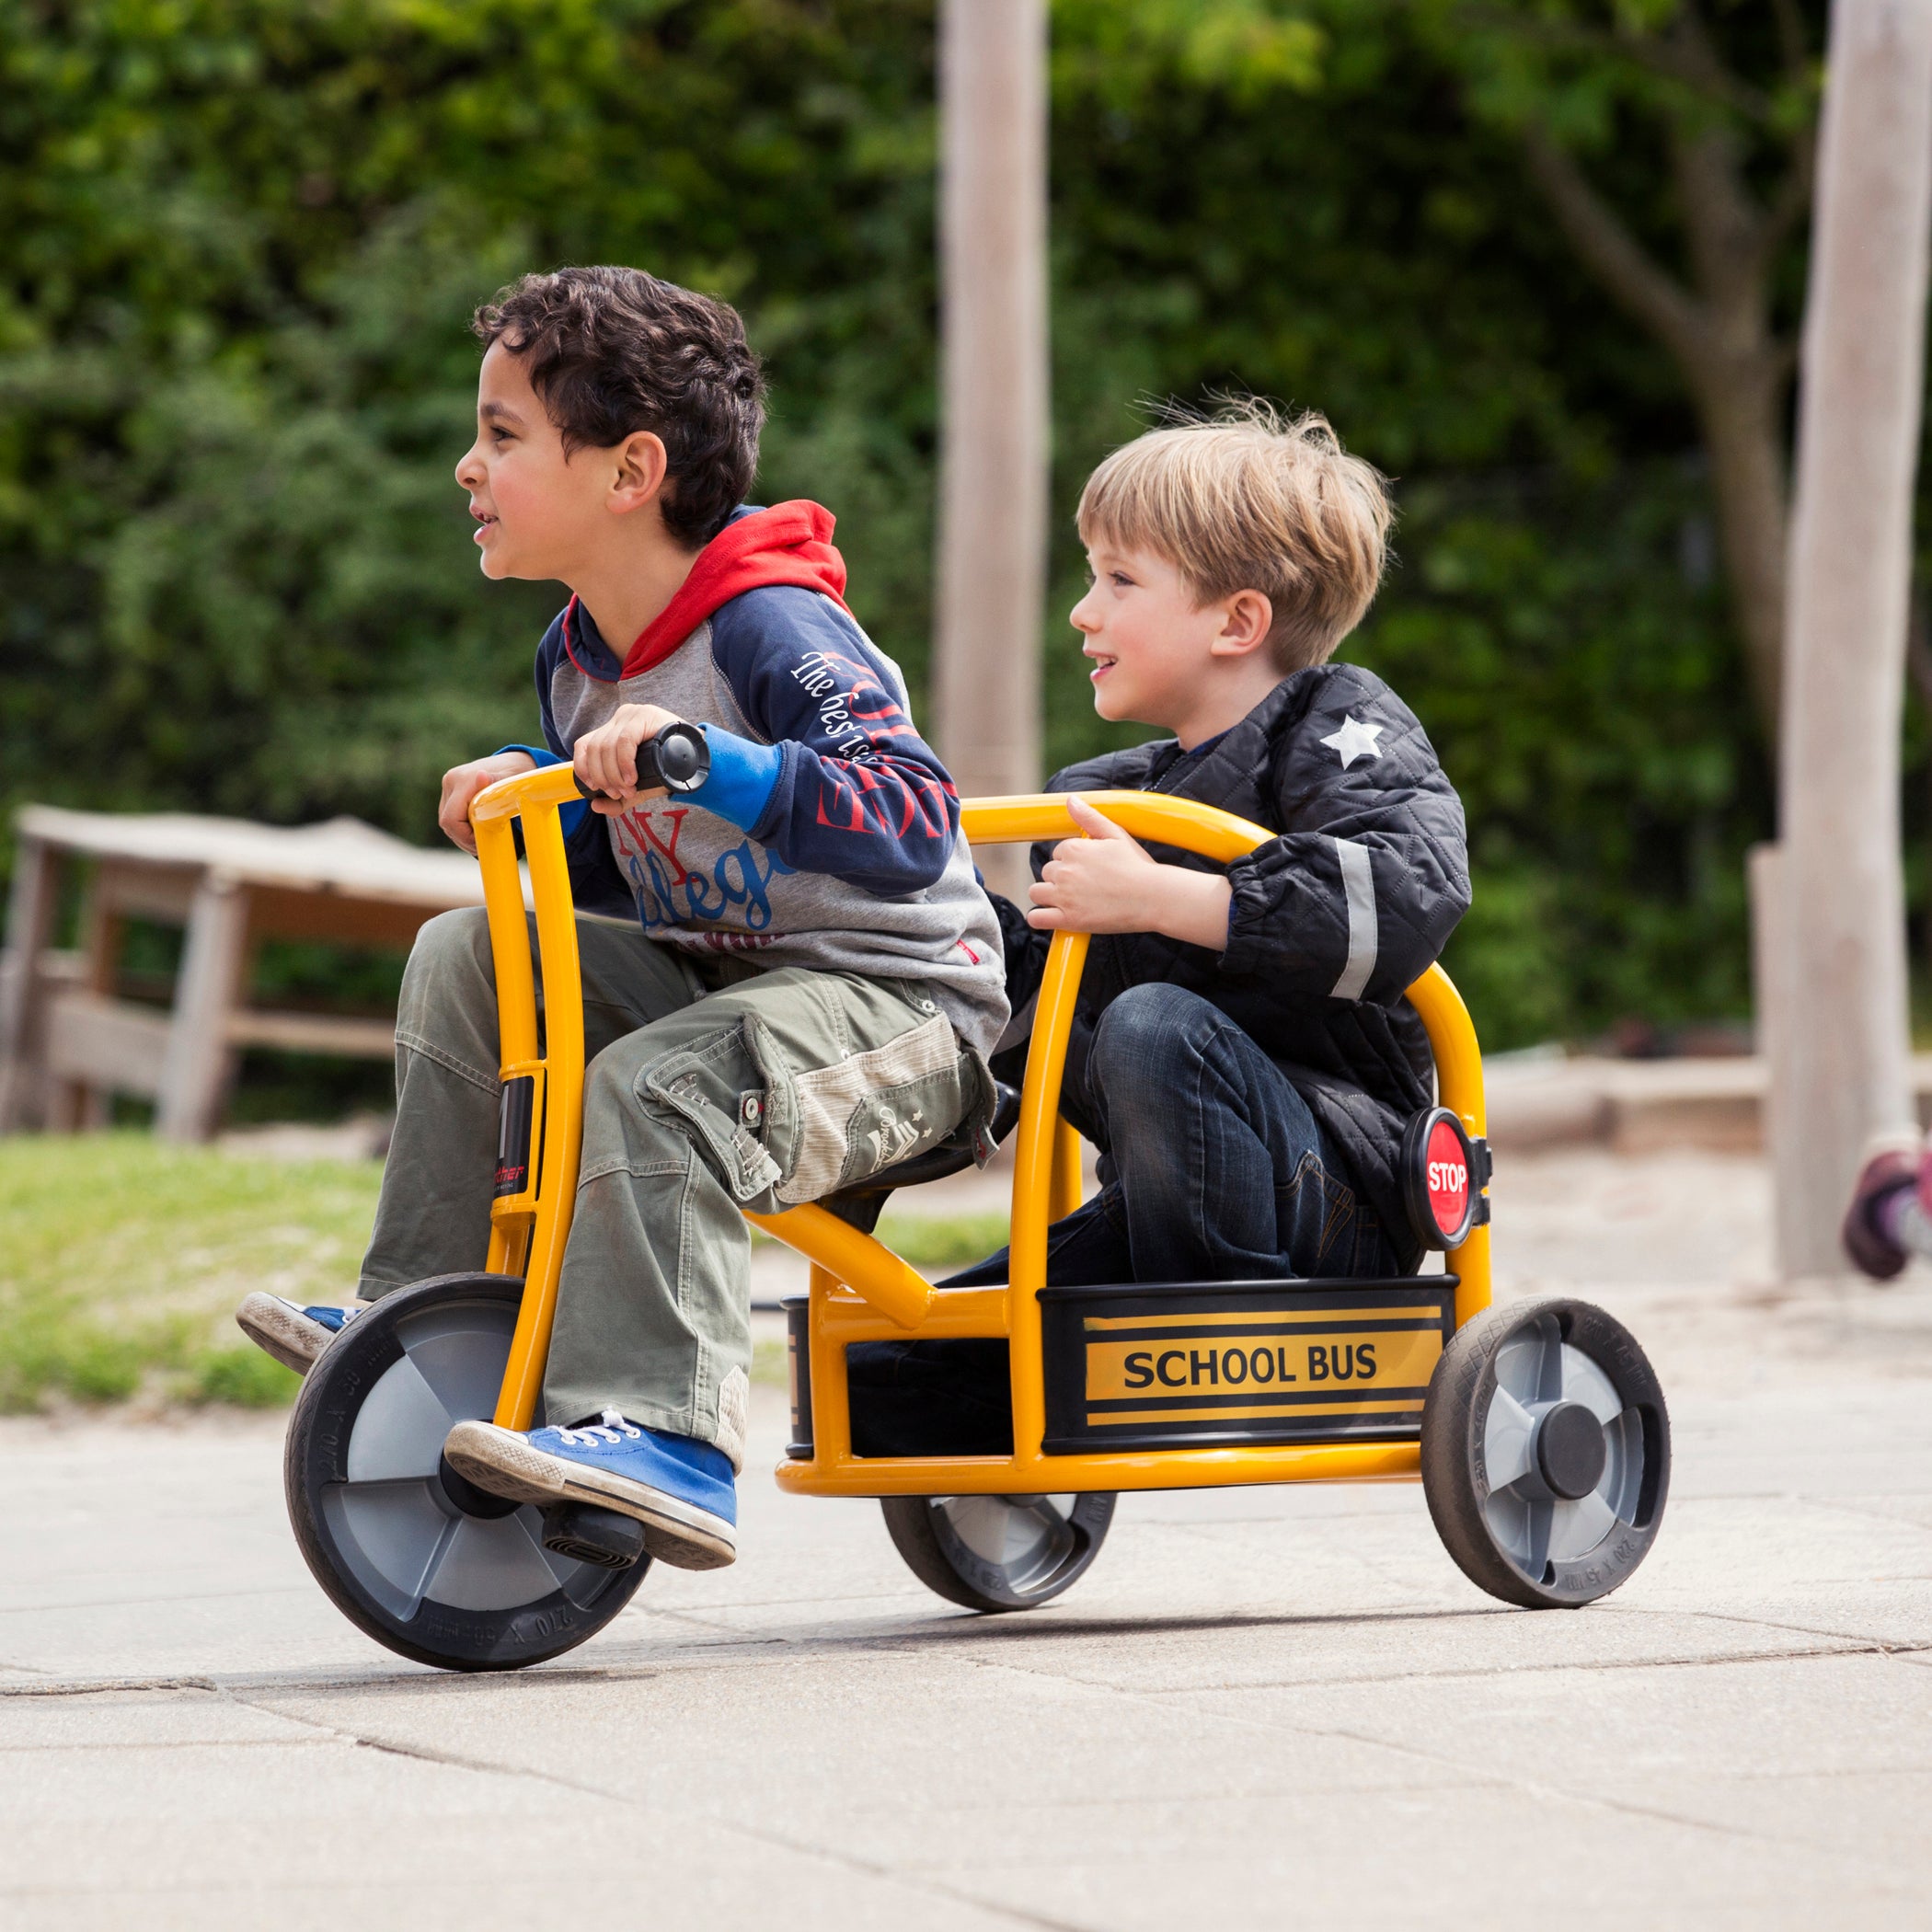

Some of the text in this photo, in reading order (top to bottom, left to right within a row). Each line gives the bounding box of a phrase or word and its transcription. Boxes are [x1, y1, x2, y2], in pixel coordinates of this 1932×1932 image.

[790, 651, 841, 697] The
[819, 691, 862, 739] best
[1428, 1161, 1467, 1193] STOP
[1123, 1343, 1377, 1388] SCHOOL BUS
[535, 1604, 574, 1639] 270
